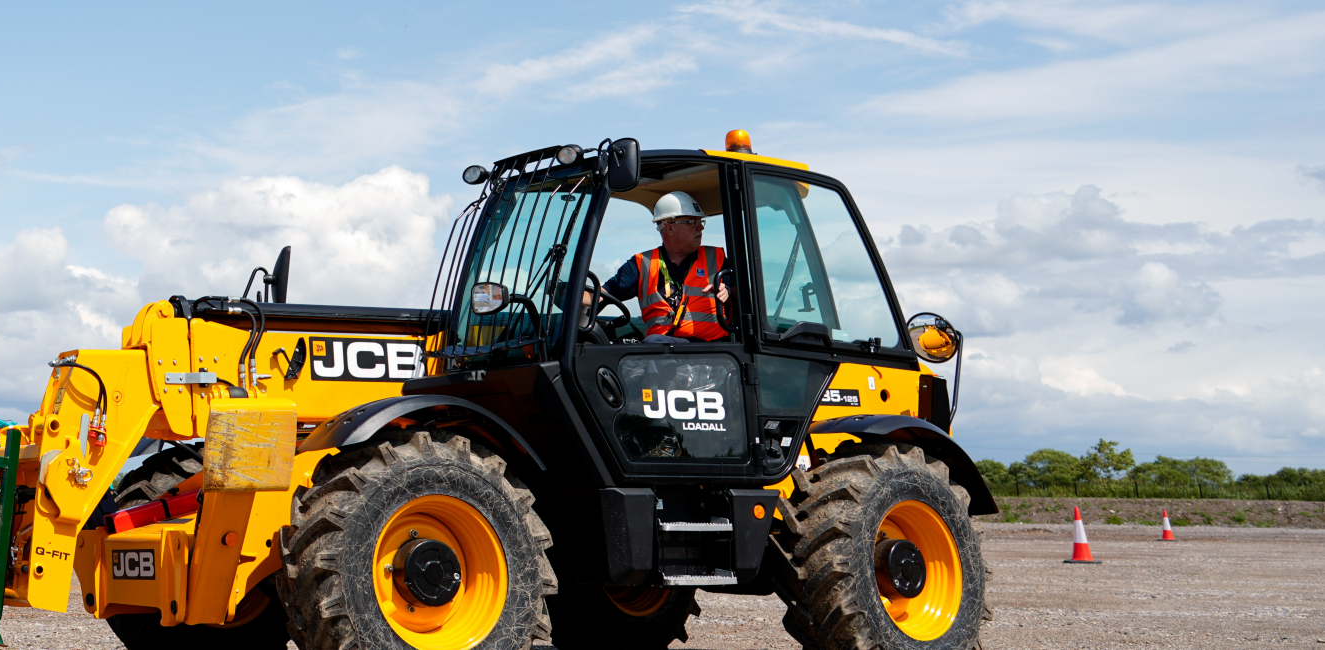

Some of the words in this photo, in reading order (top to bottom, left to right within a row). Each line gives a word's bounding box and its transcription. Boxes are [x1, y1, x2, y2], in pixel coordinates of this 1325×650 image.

[313, 341, 425, 379] JCB
[643, 389, 726, 421] JCB
[682, 421, 727, 432] LOADALL
[35, 546, 71, 561] Q-FIT
[113, 551, 155, 577] JCB
